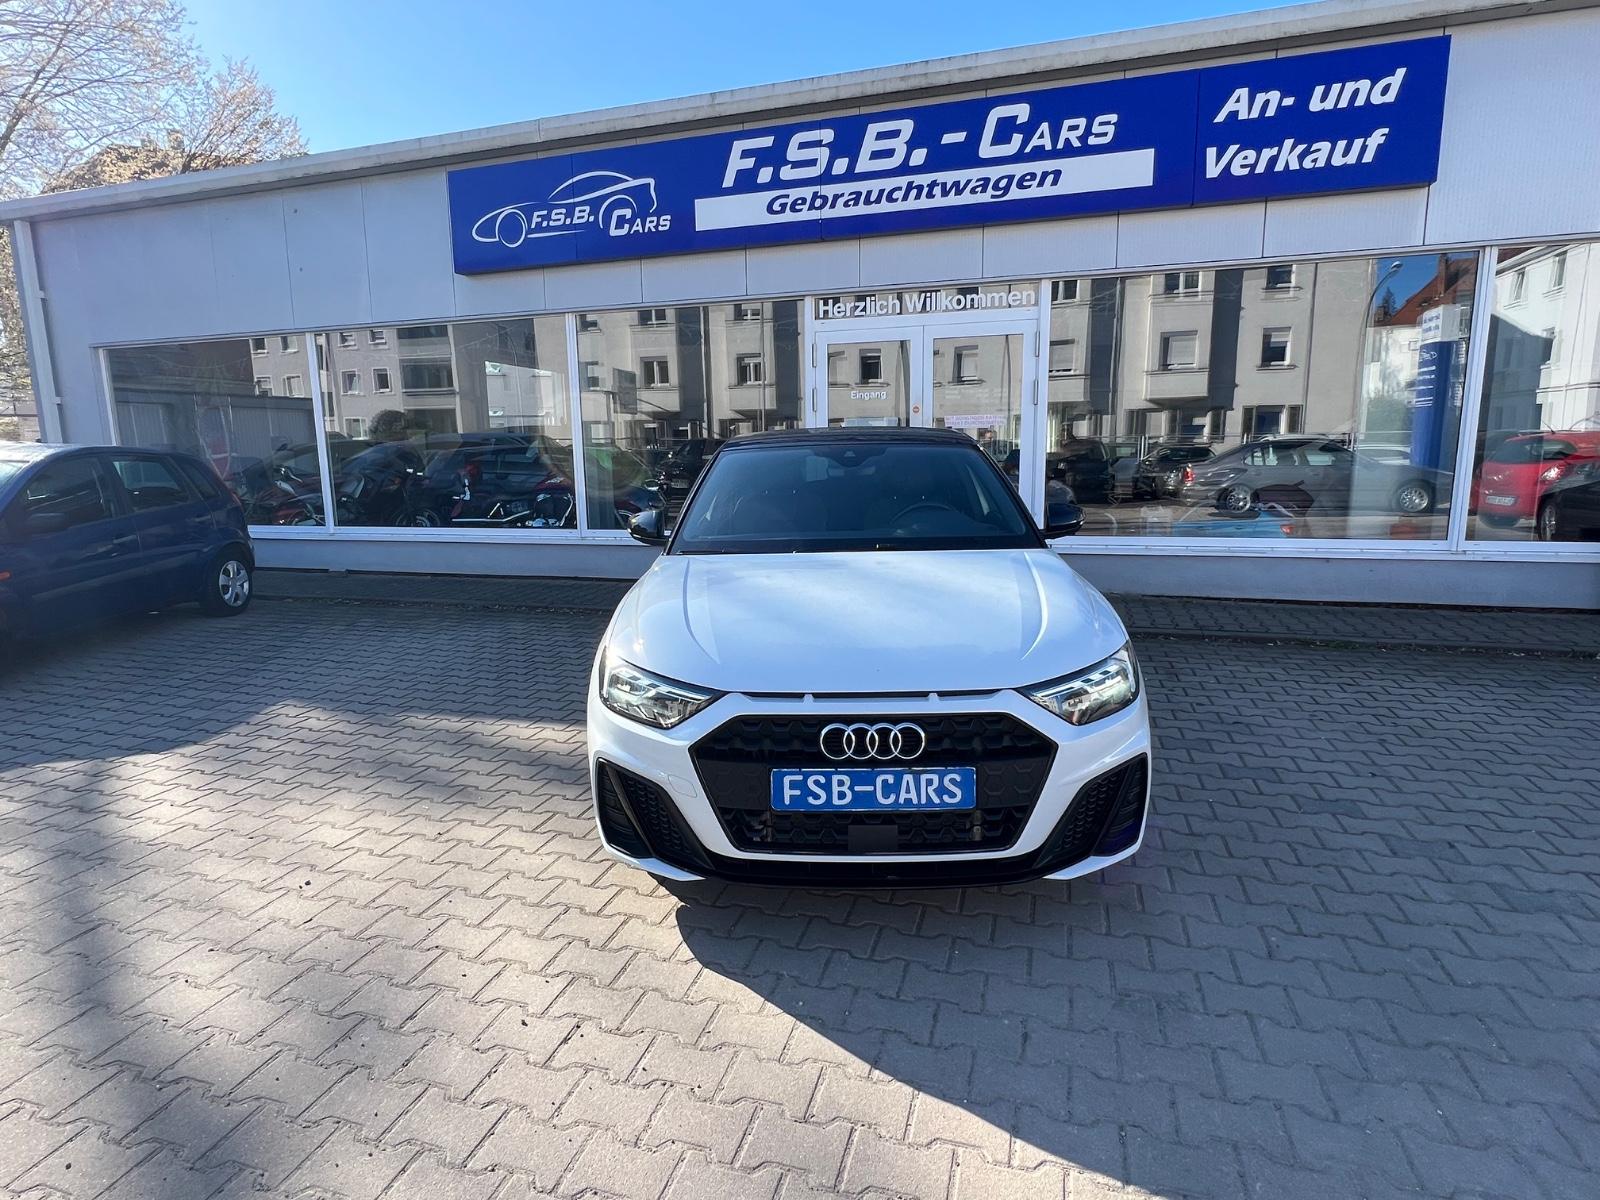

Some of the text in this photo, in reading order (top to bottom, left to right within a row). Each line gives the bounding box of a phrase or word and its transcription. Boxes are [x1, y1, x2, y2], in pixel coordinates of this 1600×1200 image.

[1214, 67, 1407, 124] An- und
[1206, 127, 1390, 180] Verkauf
[766, 167, 1062, 217] Gebrauchtwagen
[531, 205, 595, 229] F.S.B.
[819, 290, 1035, 318] Herzlich Willkommen
[850, 390, 887, 400] Eingang
[783, 773, 963, 805] FSB-CARS
